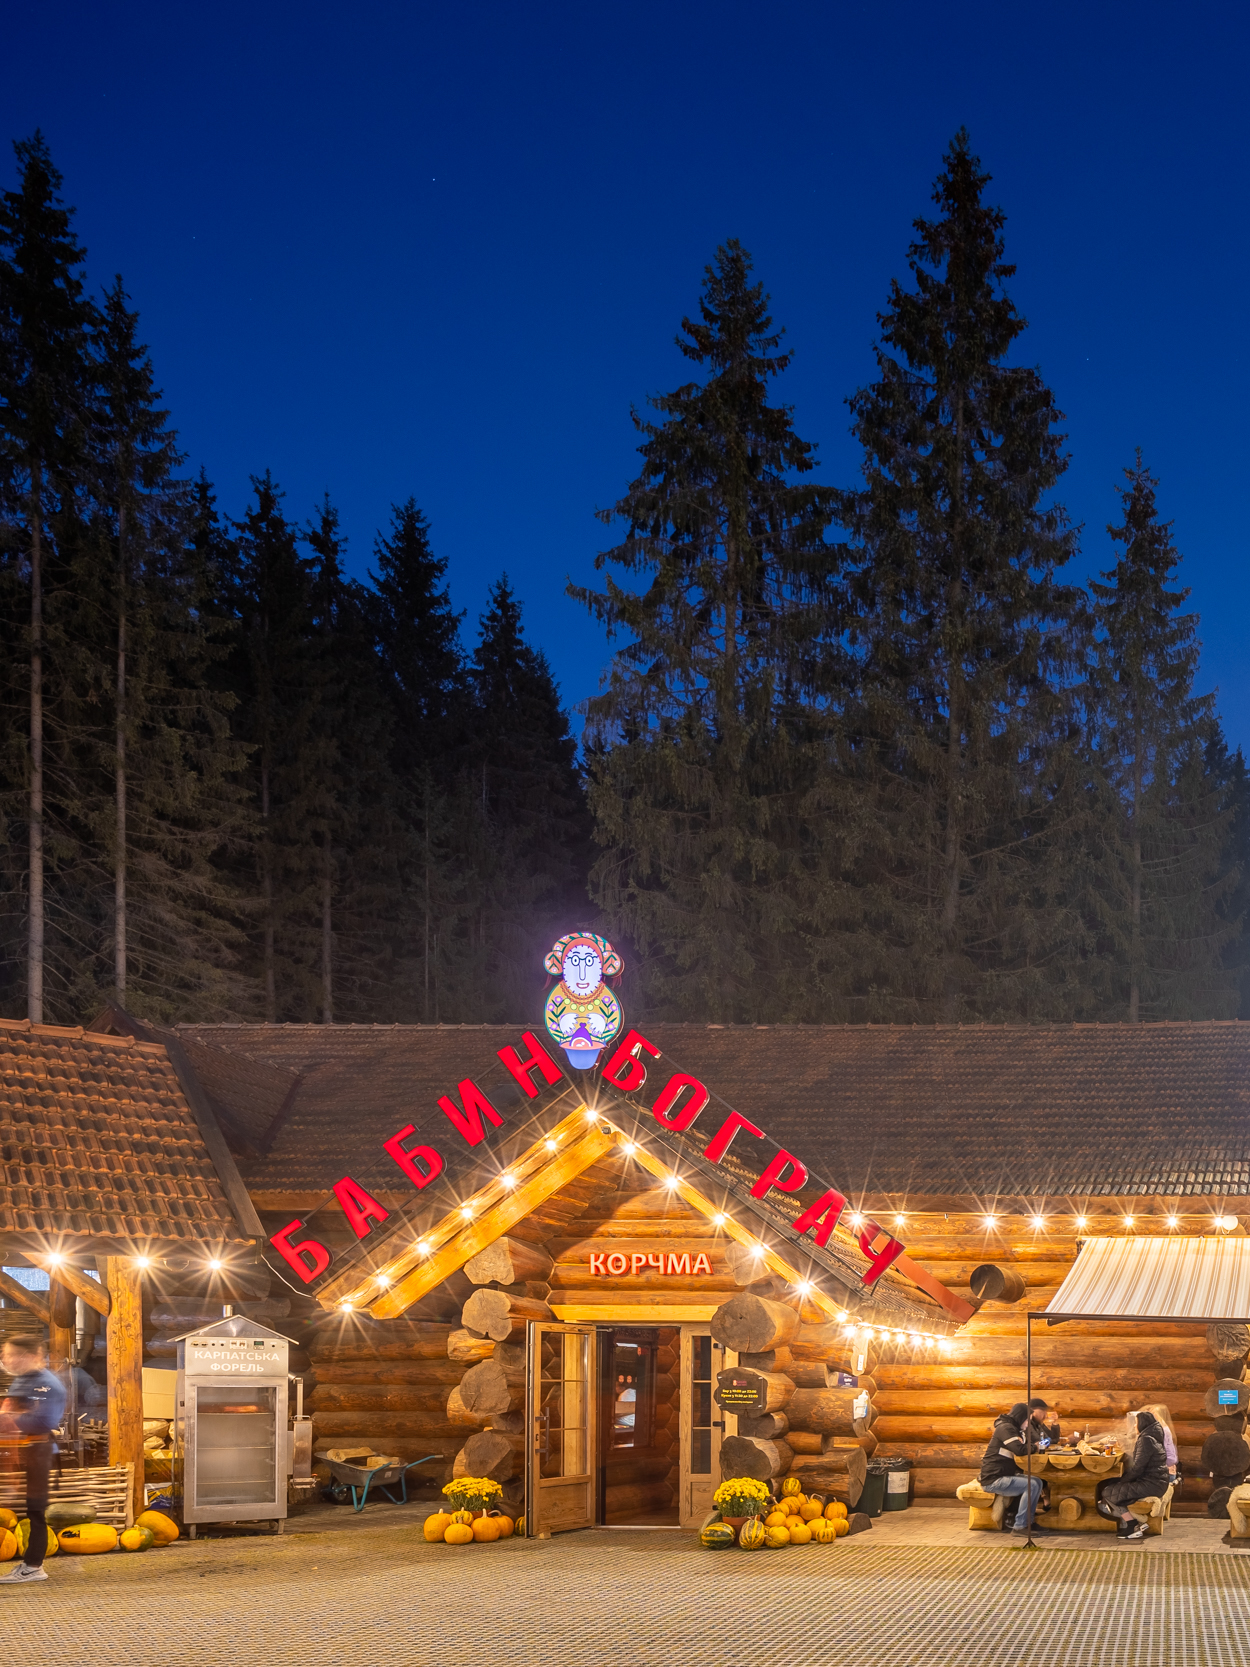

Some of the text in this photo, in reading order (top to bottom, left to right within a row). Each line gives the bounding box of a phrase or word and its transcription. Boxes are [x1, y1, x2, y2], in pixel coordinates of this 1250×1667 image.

[270, 1029, 905, 1286] БАБИН БОГРАЧ
[589, 1252, 714, 1275] КОРЧМА
[194, 1350, 280, 1361] КАРПАТСЬКА
[210, 1363, 264, 1372] ФОРЕЛЬ
